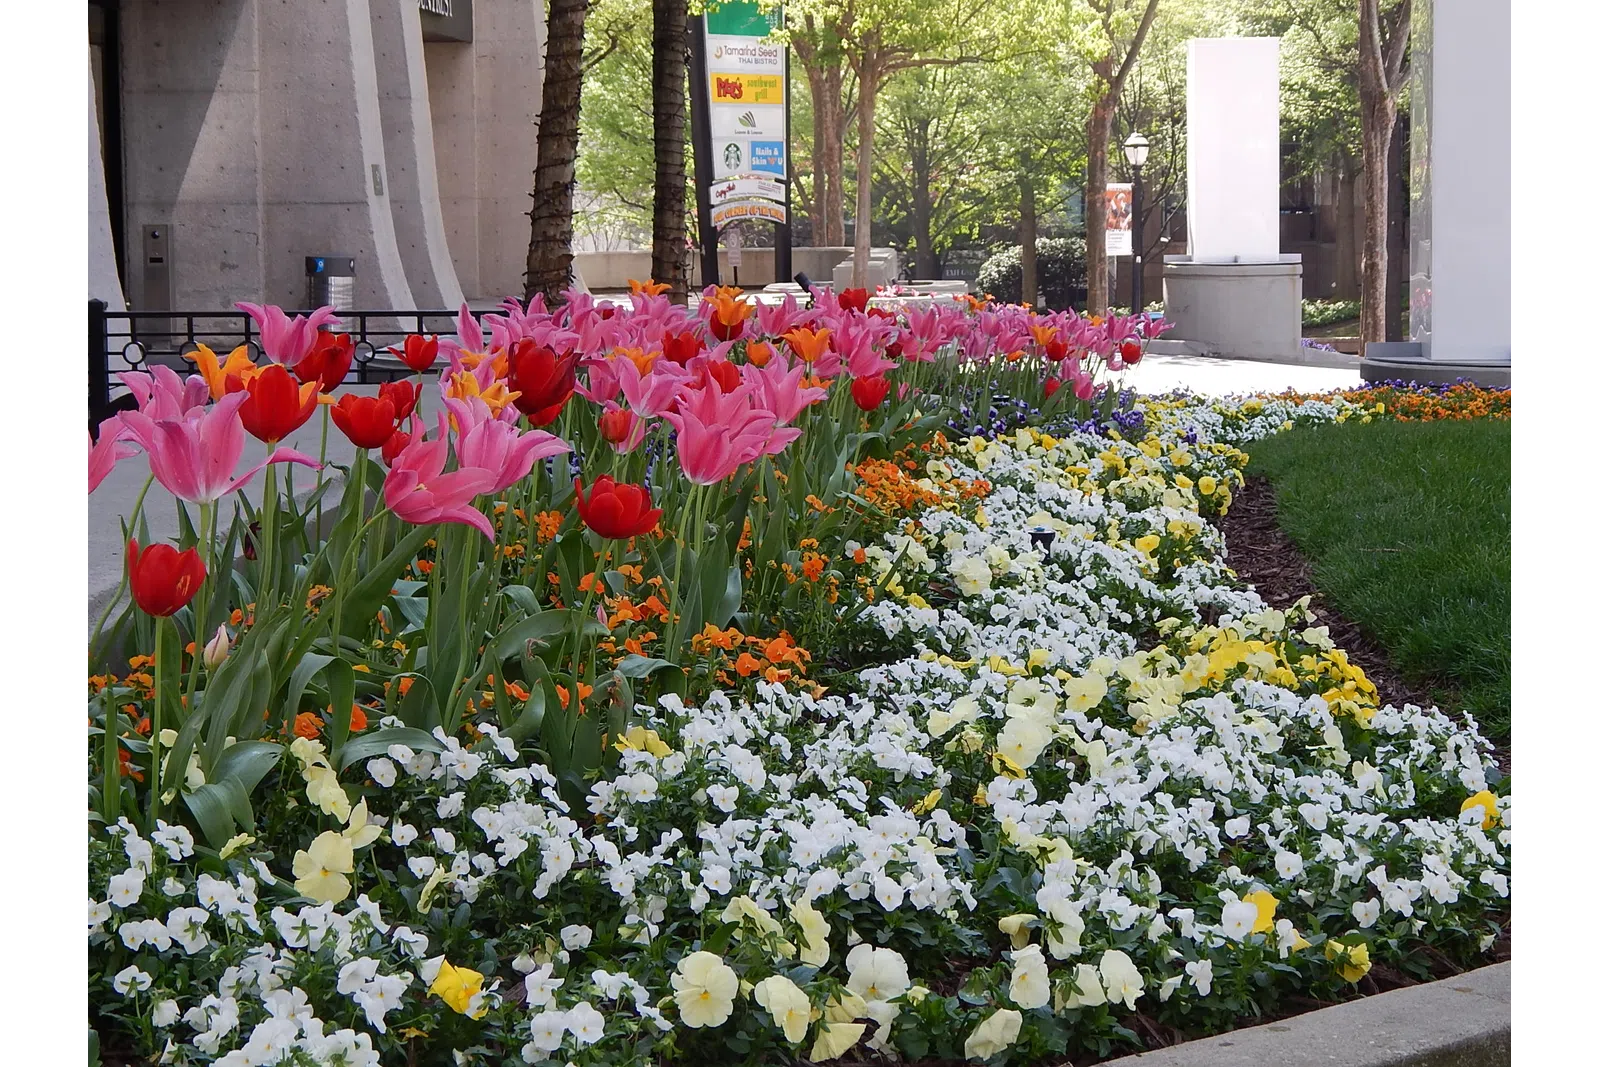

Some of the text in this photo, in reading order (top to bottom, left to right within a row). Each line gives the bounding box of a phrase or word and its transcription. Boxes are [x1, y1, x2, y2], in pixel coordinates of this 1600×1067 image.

[724, 45, 778, 58] Tamarind Seed
[747, 76, 777, 88] southwest
[755, 88, 768, 102] grill
[755, 147, 779, 156] Nails &
[752, 157, 783, 165] Skin U
